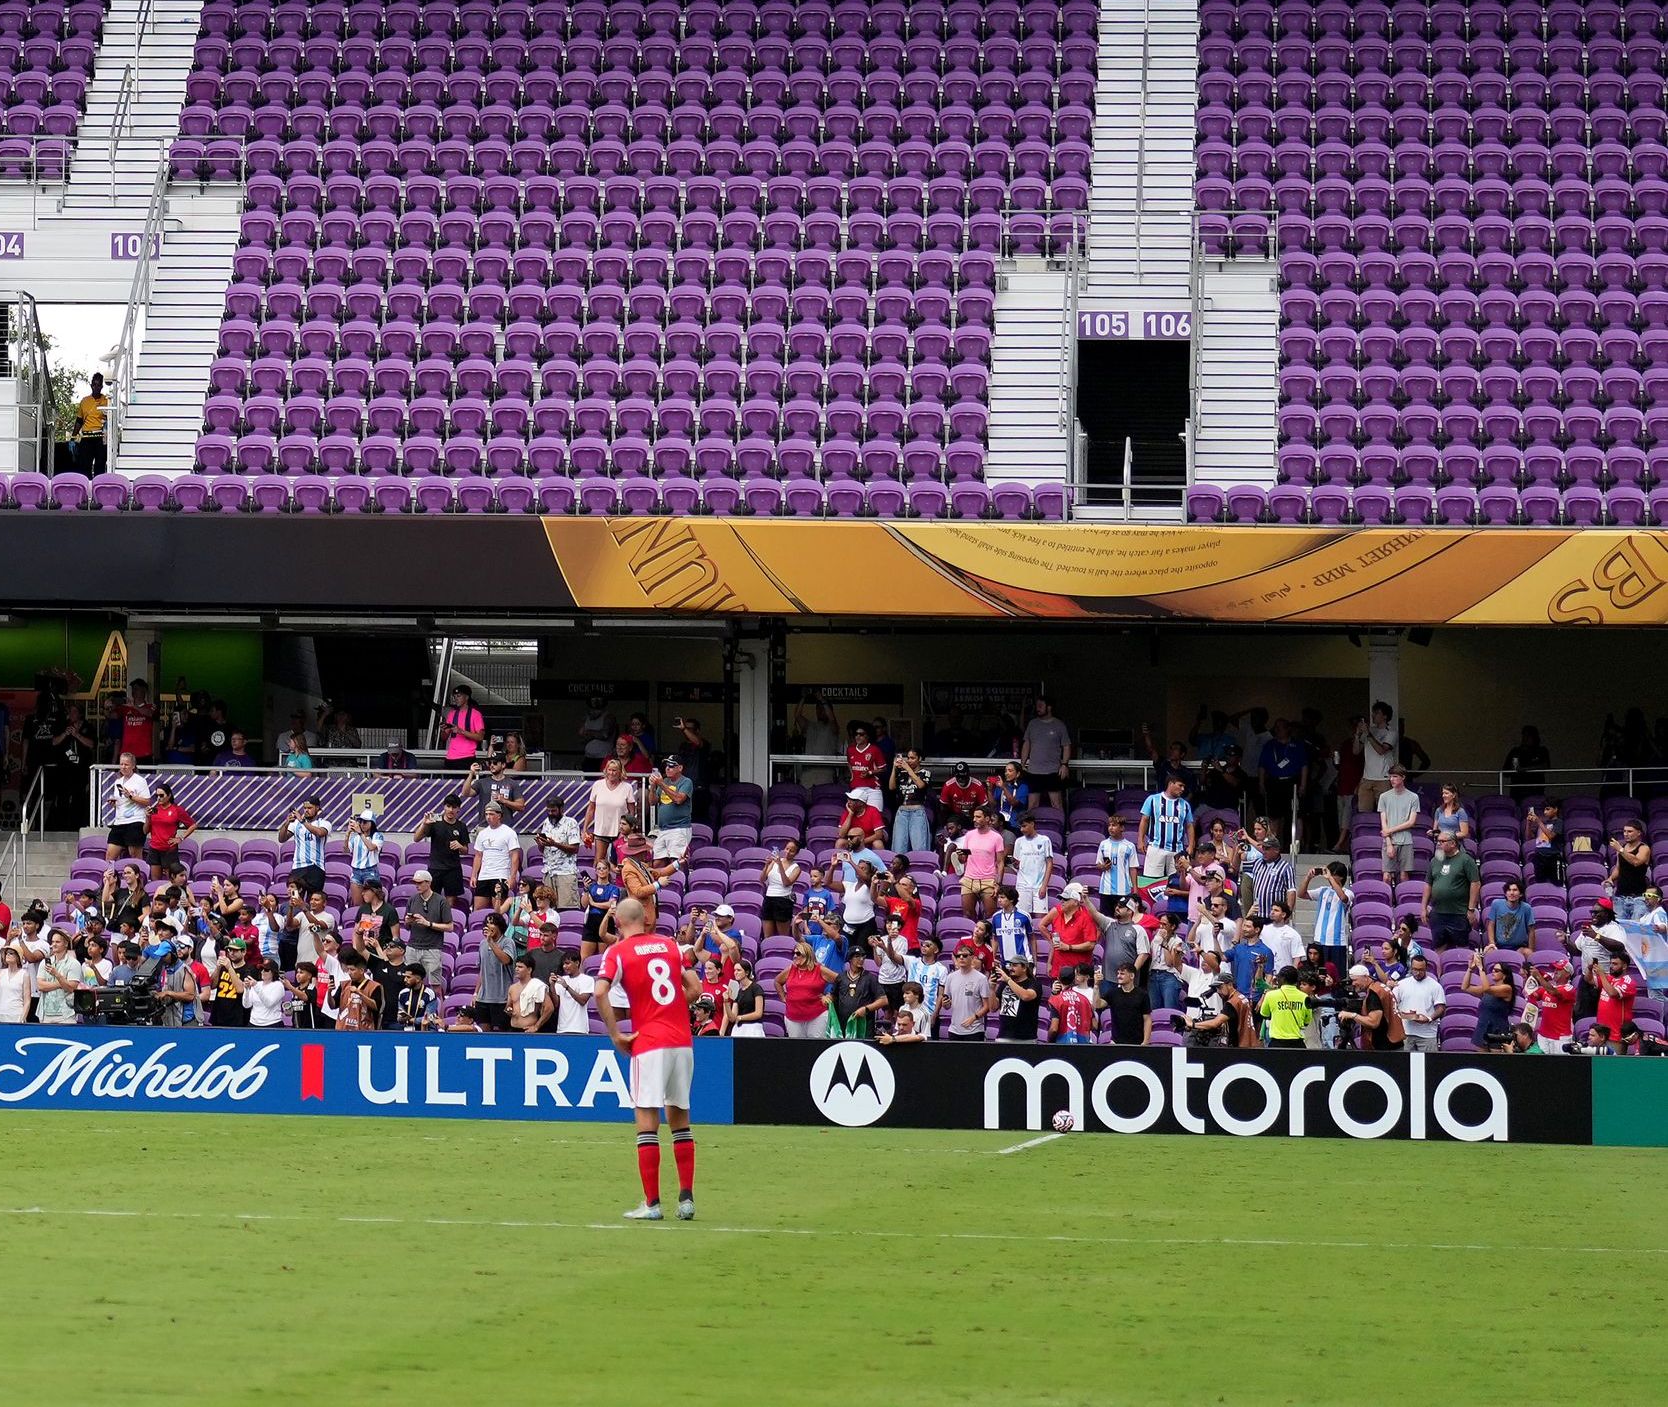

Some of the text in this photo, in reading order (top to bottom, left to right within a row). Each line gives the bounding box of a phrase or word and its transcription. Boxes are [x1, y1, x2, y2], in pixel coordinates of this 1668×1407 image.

[1080, 314, 1126, 336] 105
[1146, 314, 1192, 336] 106
[821, 687, 868, 697] COCKTAILS
[364, 798, 372, 809] 5
[217, 983, 238, 999] 22
[648, 958, 676, 1005] 8
[1277, 1000, 1304, 1011] SECURITY
[357, 1044, 638, 1109] ULTRA
[983, 1047, 1509, 1142] motorola
